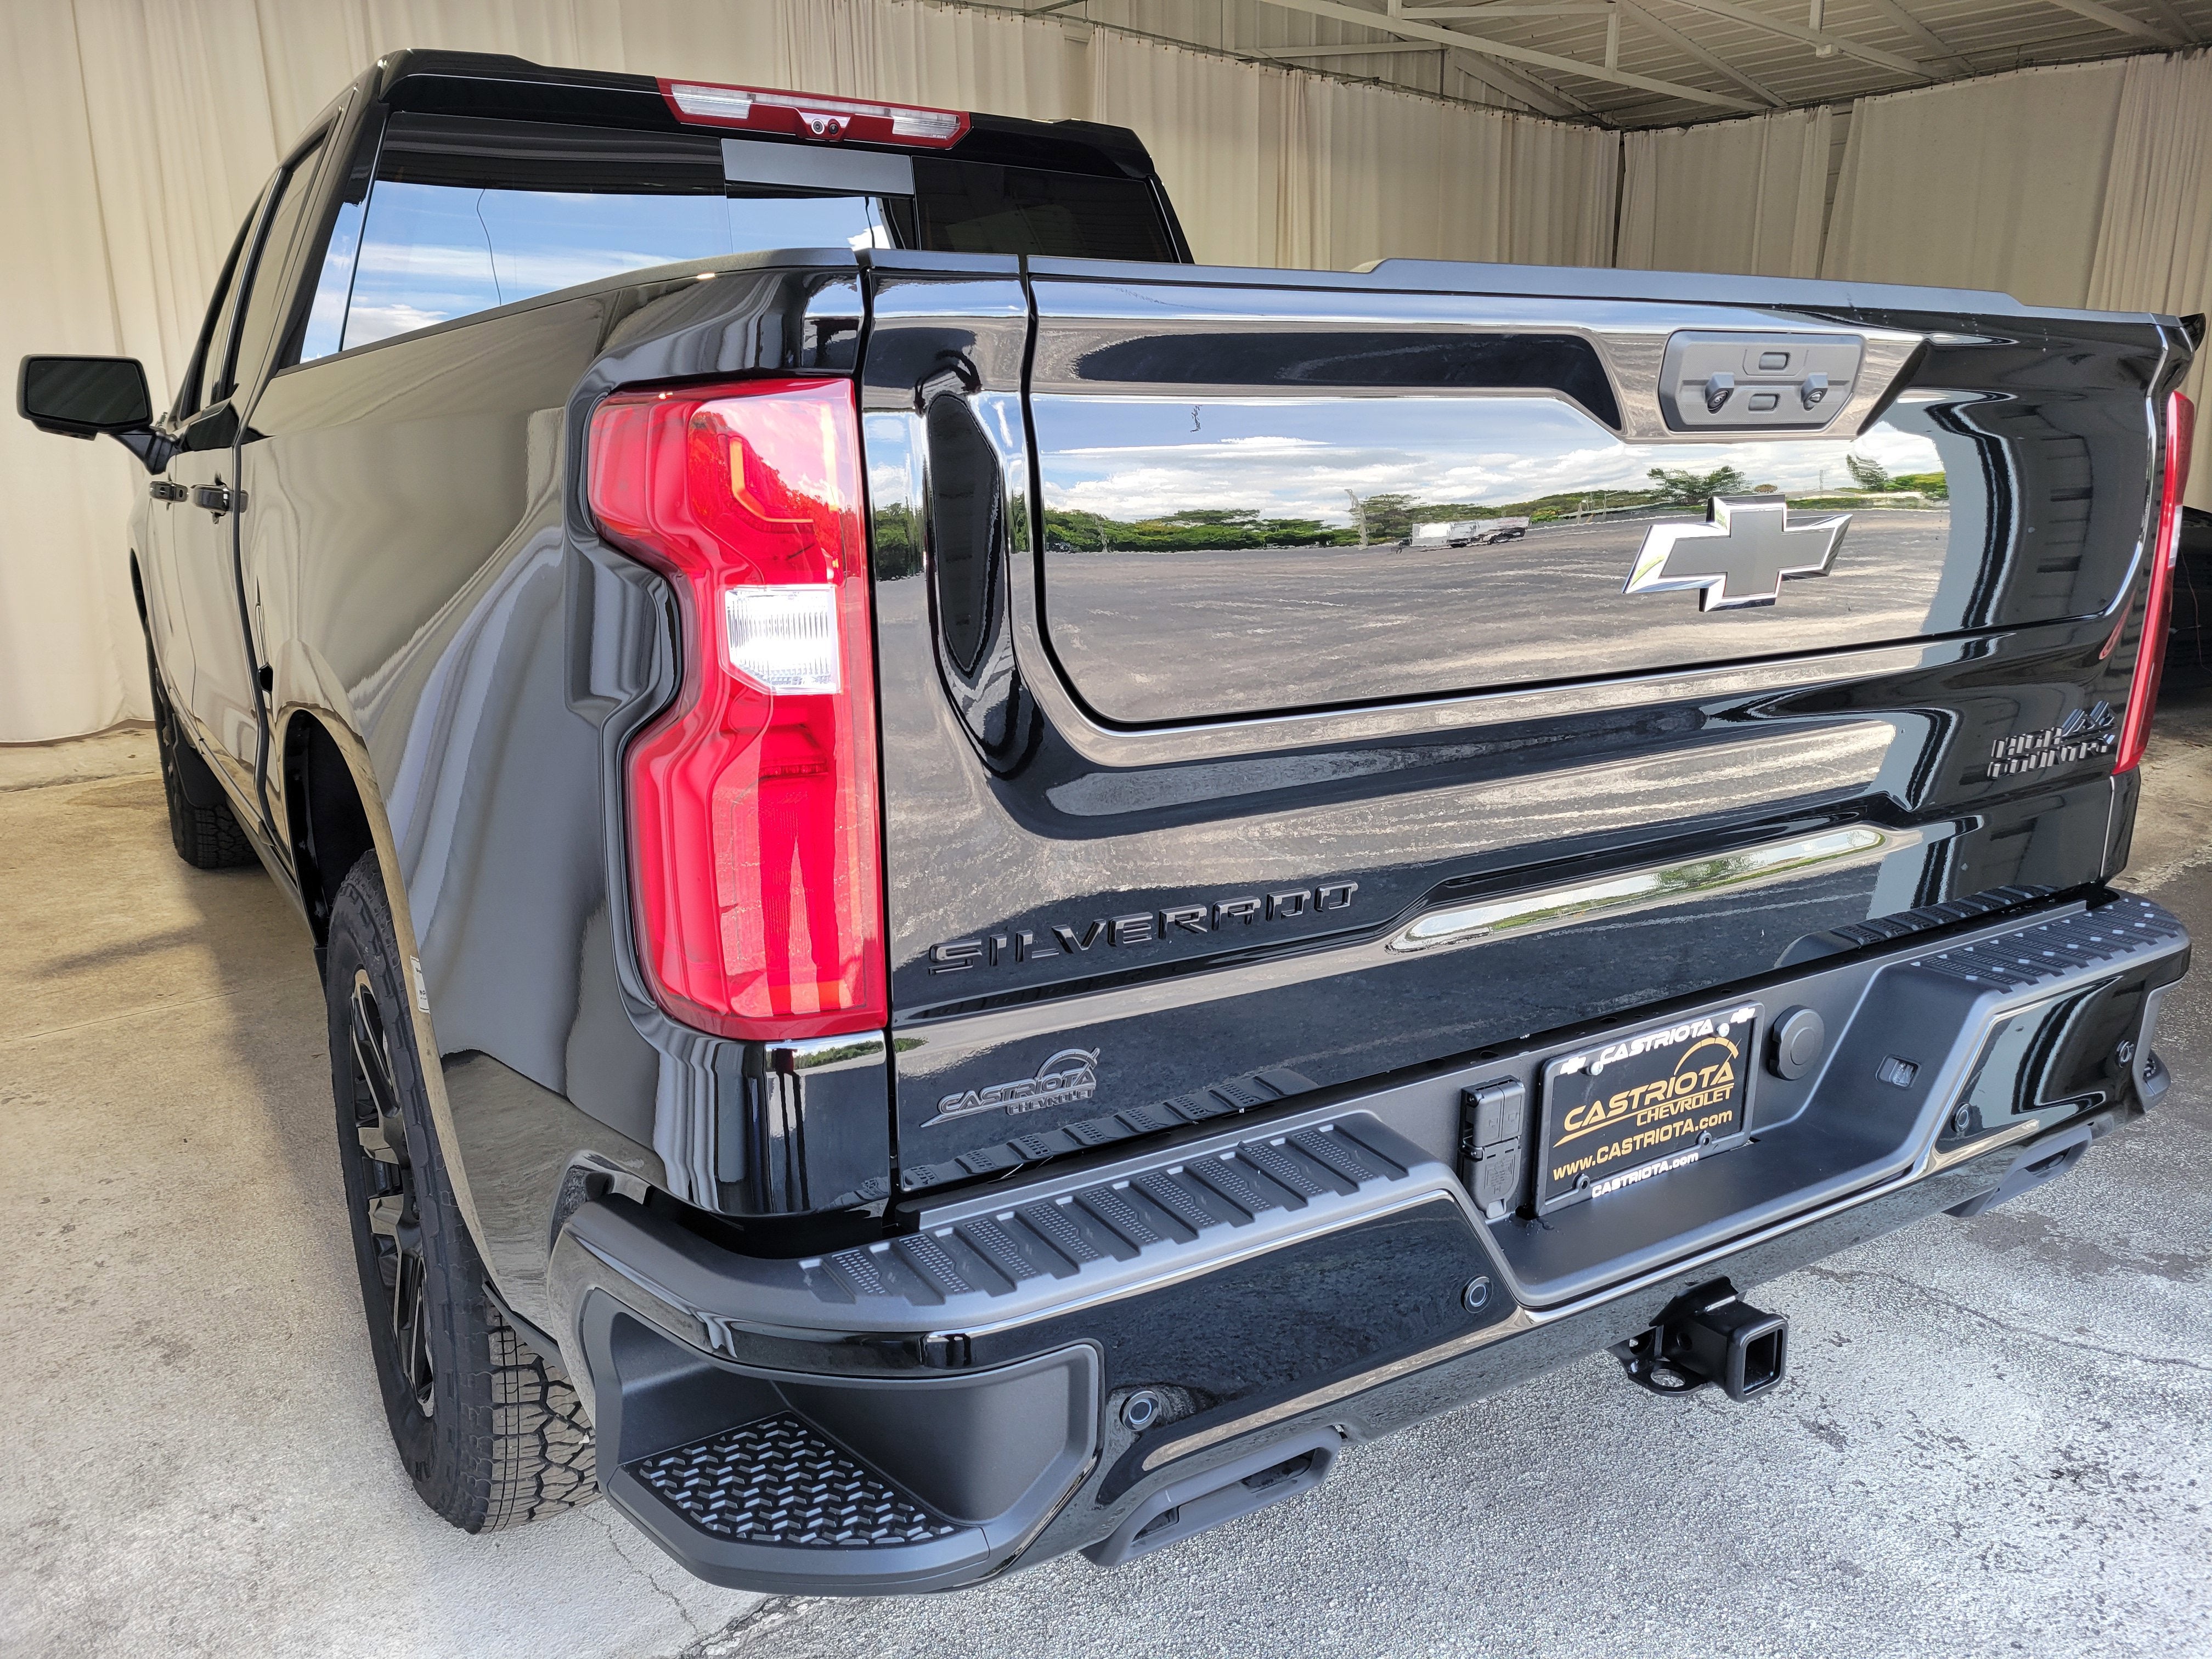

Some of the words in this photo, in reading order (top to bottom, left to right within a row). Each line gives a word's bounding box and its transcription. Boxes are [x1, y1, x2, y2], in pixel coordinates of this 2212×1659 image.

[928, 880, 1359, 975] SILVERADO
[1599, 1018, 1714, 1066] CASTRIOTA
[939, 1069, 1096, 1114] CASTRIOTA
[1008, 1089, 1093, 1115] CHEVROLET
[1564, 1061, 1735, 1131] CASTRIOTA
[1637, 1086, 1734, 1126] CHEVROLET
[1553, 1110, 1733, 1181] www.CASTRIOTA.com
[1592, 1152, 1699, 1198] CASTRIOTA.com
